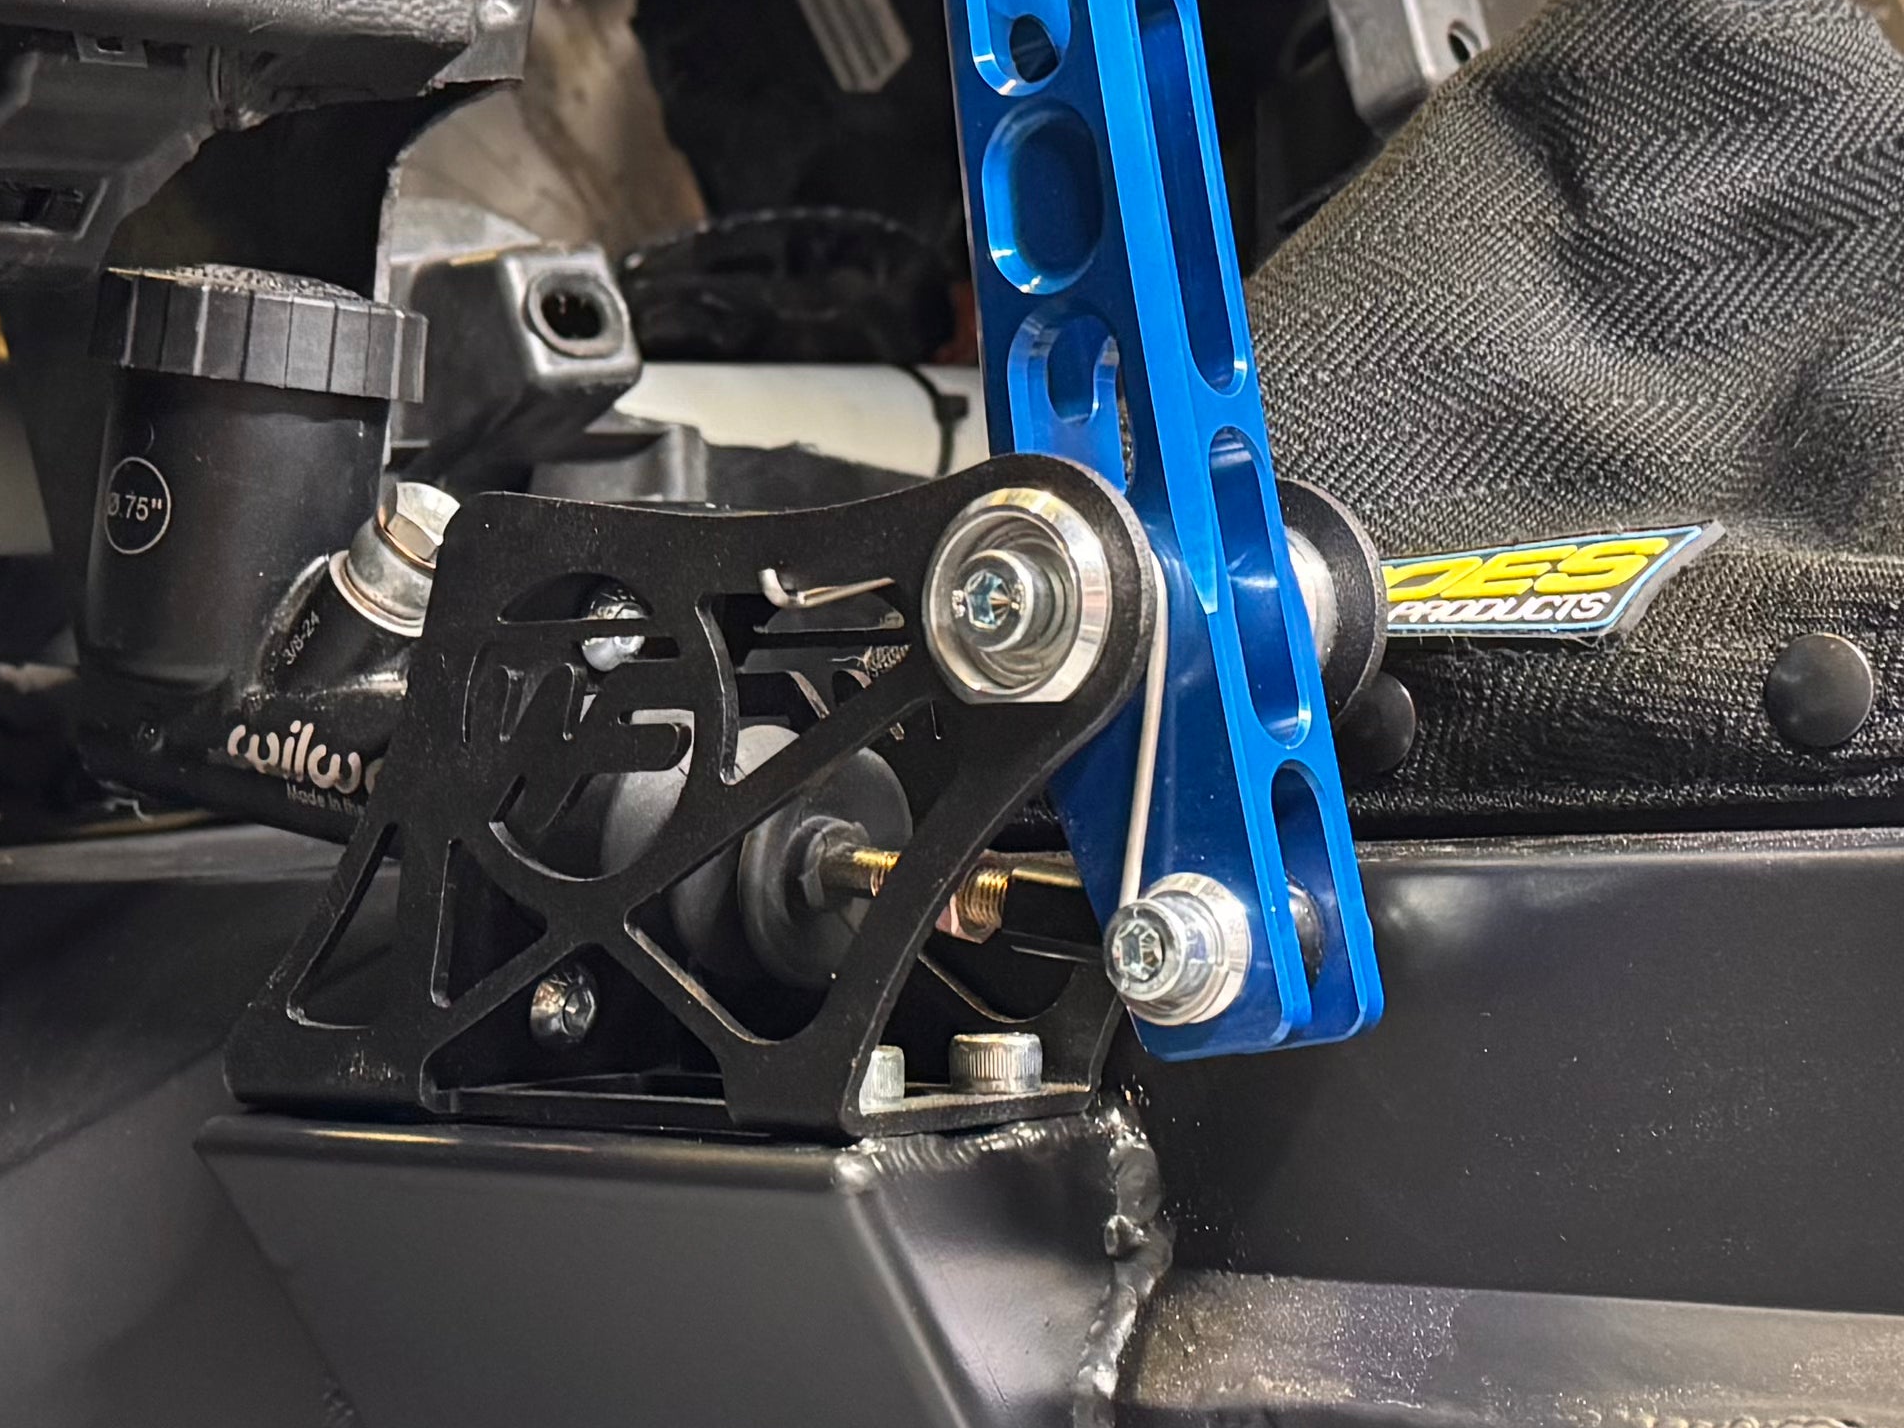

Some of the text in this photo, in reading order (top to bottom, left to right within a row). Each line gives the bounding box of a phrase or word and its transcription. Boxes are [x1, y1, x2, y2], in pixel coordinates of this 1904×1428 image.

[1387, 592, 1612, 623] PRODUCTS
[281, 609, 321, 665] 3/8-24
[286, 780, 326, 809] Made
